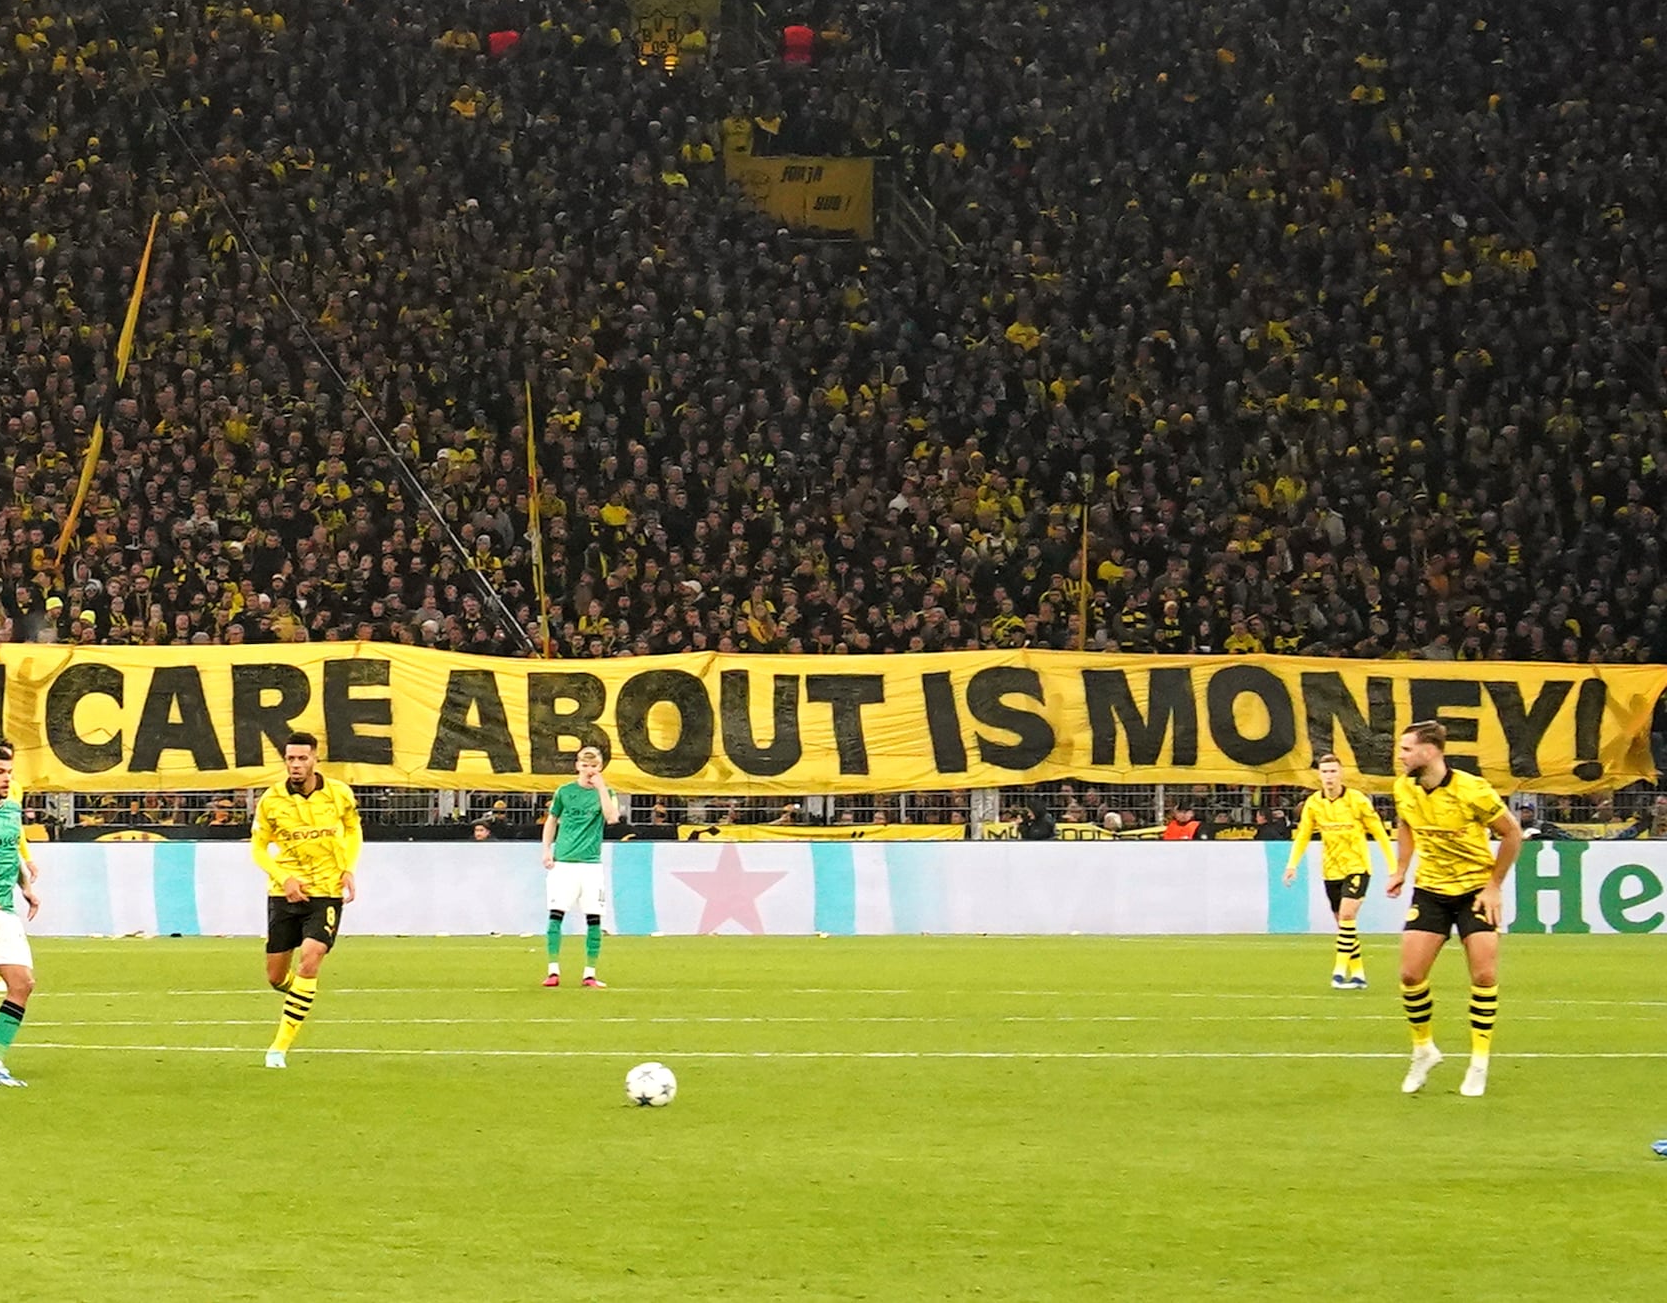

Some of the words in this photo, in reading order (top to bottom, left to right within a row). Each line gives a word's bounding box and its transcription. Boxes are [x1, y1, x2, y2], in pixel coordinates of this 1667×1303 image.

[46, 658, 395, 774] CARE
[427, 668, 885, 778] ABOUT
[923, 666, 1056, 773] IS
[1083, 664, 1608, 782] MONEY!
[326, 906, 336, 927] 8
